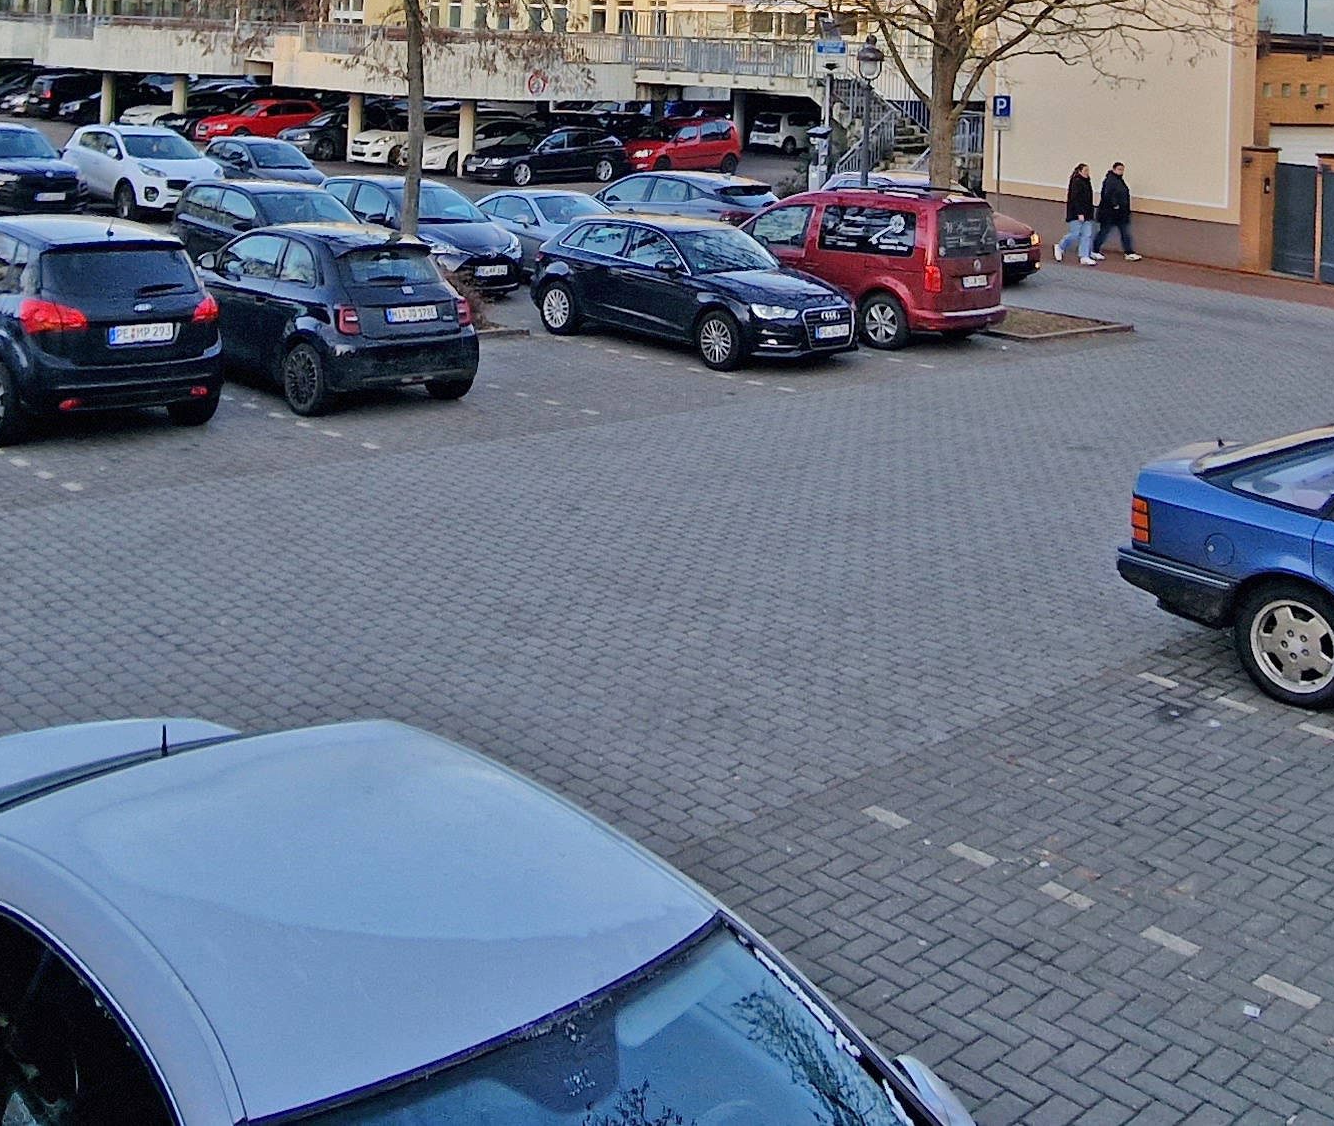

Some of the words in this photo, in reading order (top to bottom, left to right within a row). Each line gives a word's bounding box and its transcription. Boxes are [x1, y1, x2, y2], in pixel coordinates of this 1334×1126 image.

[996, 97, 1007, 115] P
[116, 327, 129, 340] PE
[152, 325, 171, 337] 293
